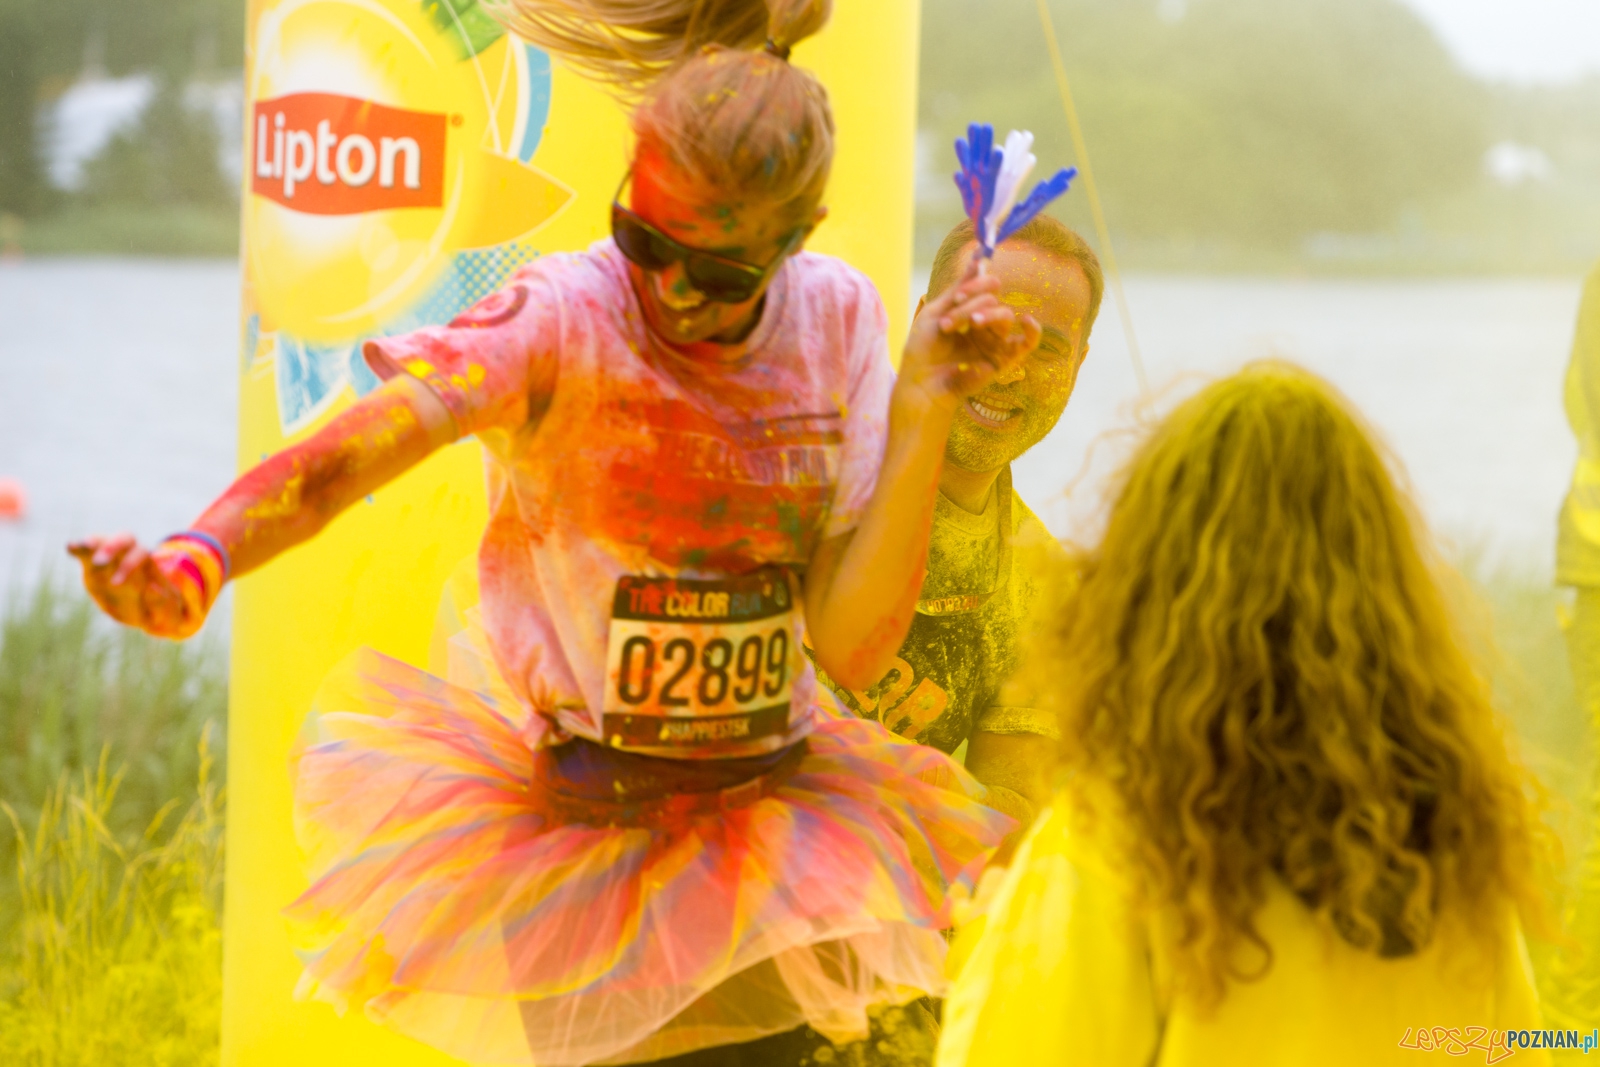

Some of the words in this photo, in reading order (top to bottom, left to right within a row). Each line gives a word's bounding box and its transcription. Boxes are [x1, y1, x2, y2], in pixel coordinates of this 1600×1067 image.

[256, 112, 421, 198] Lipton
[629, 587, 664, 615] THE
[665, 591, 730, 618] COLOR
[618, 628, 788, 706] 02899
